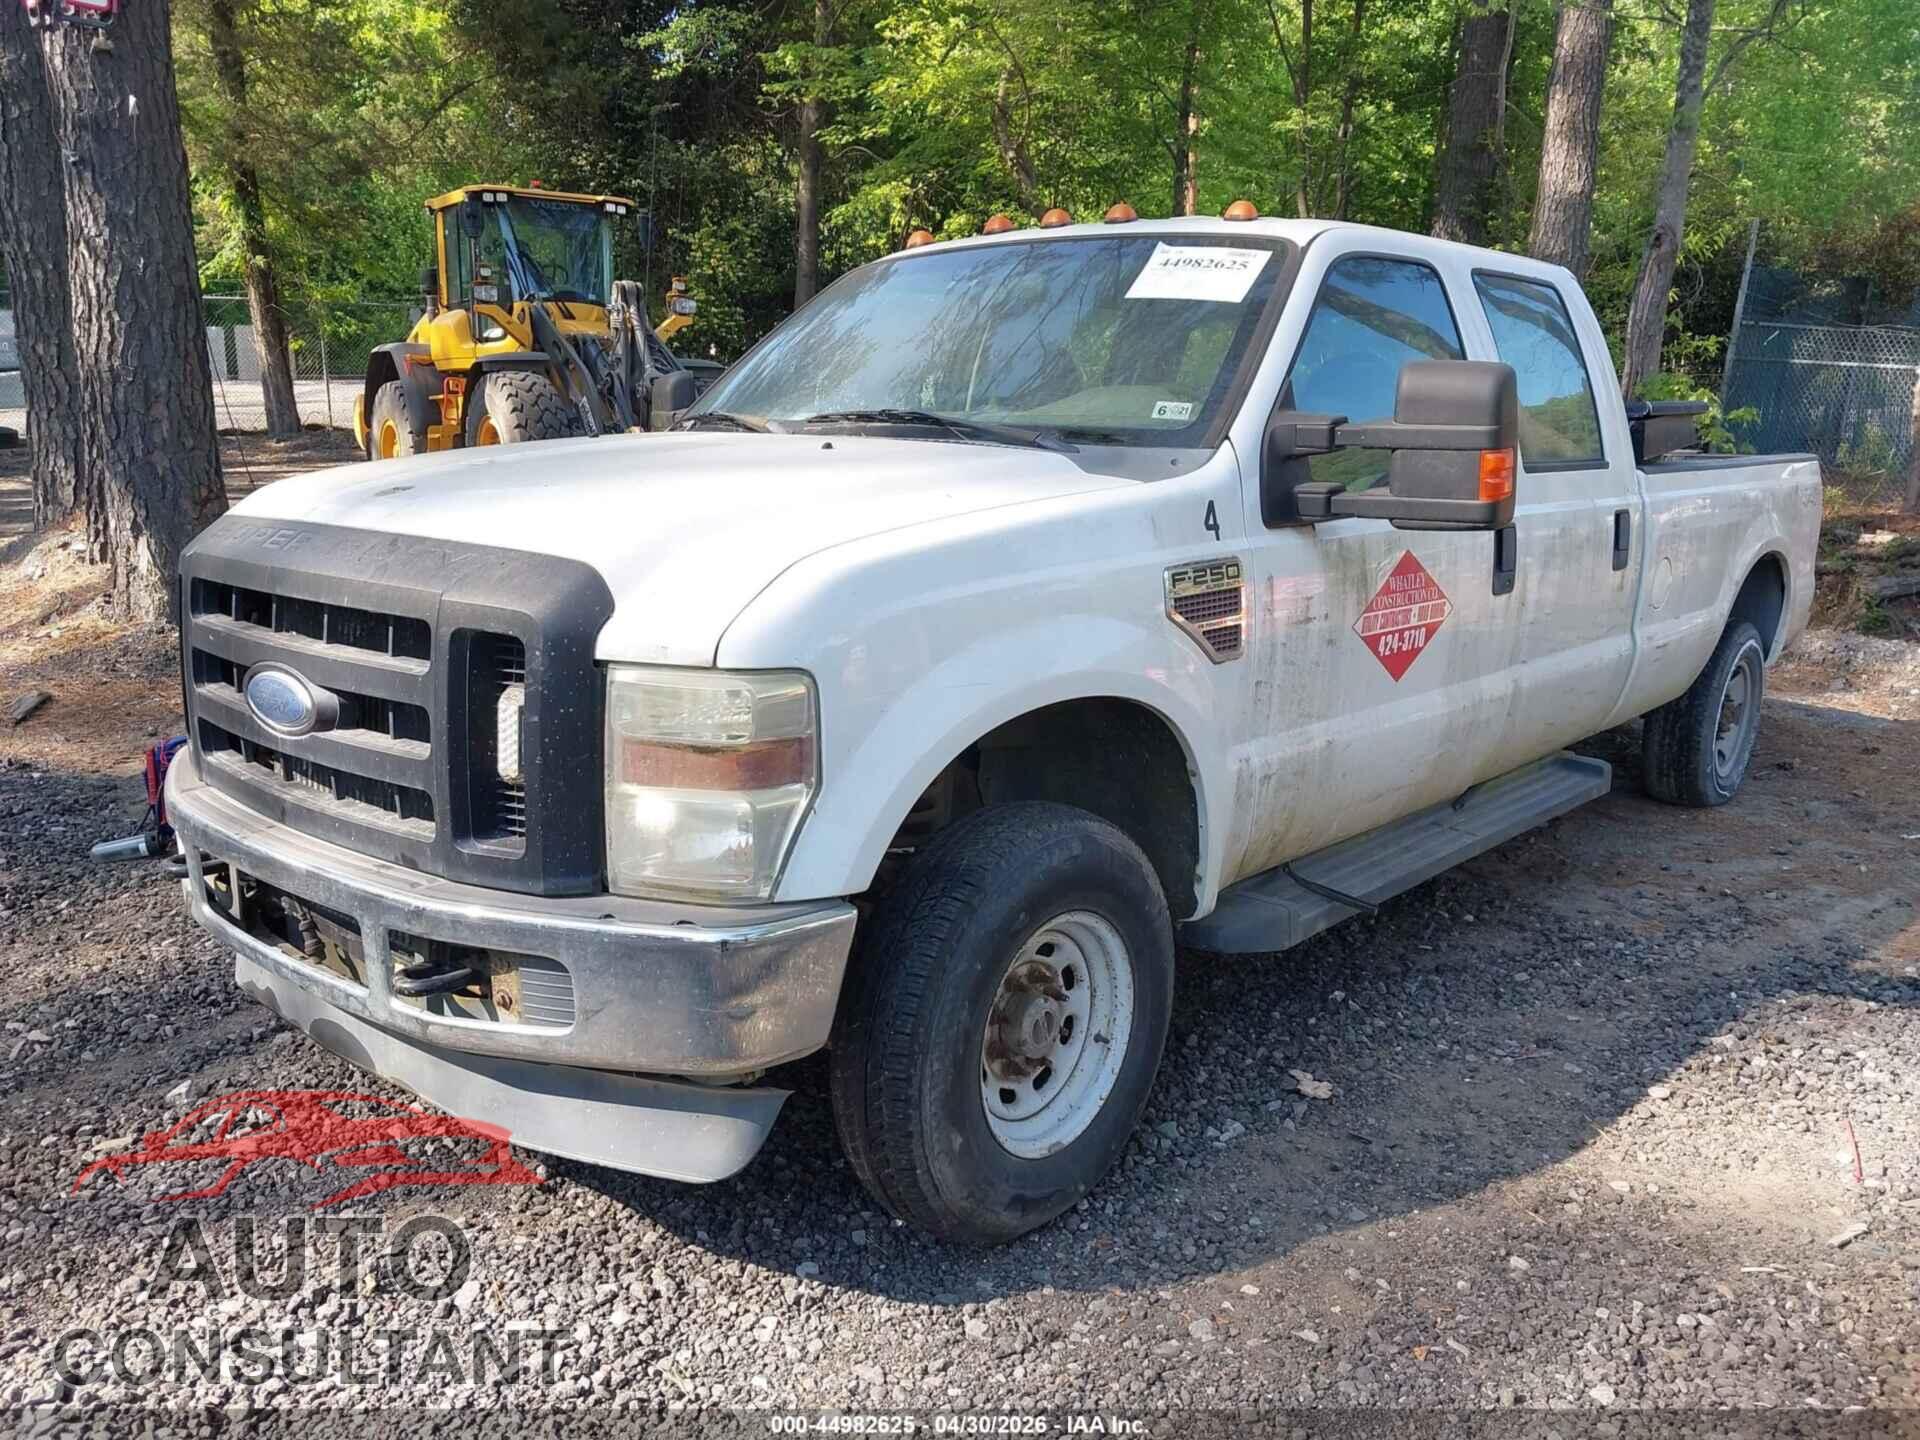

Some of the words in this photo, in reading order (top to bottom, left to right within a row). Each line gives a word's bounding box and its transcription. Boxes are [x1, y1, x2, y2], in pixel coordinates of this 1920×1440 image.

[1158, 257, 1250, 271] 44982625
[1157, 405, 1168, 416] 6
[1204, 499, 1221, 542] 4
[1373, 588, 1427, 610] CONSTRUCTION
[1378, 626, 1426, 656] 424-3710
